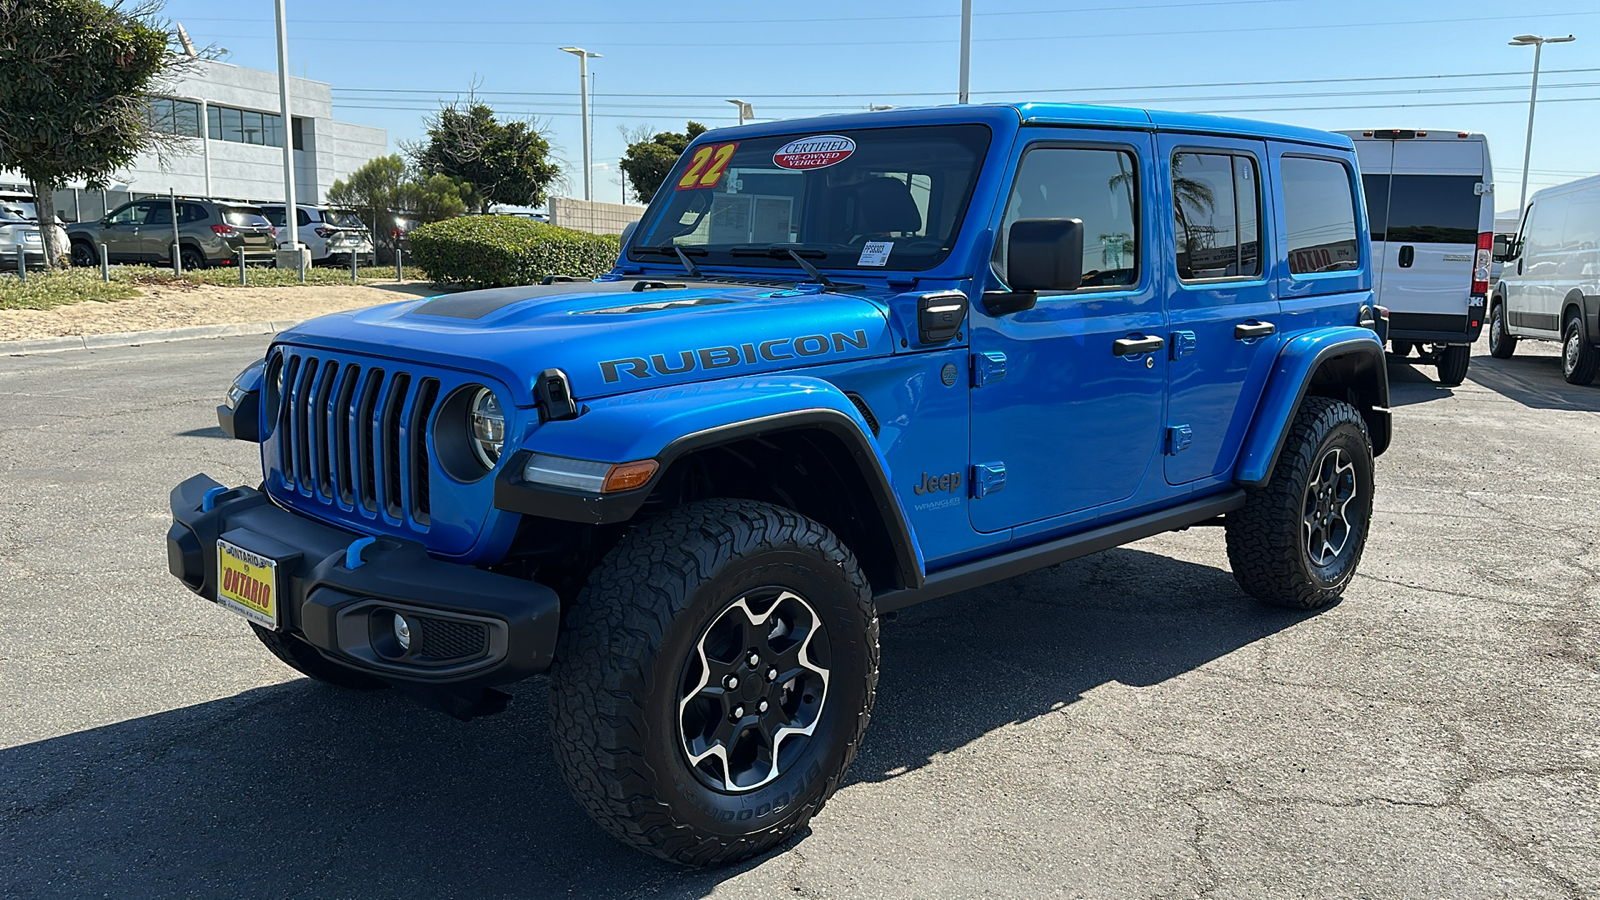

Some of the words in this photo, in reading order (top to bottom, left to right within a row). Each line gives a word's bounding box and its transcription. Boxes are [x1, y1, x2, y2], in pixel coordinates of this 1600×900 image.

[782, 152, 840, 161] PRE-OWNED
[784, 140, 849, 154] CERTIFIED
[679, 143, 735, 188] 22
[788, 158, 829, 167] VEHICLE
[598, 329, 870, 385] RUBICON
[913, 472, 961, 495] Jeep
[914, 497, 960, 511] WRANGLER
[231, 546, 259, 567] ONTARIO
[223, 567, 271, 608] ONTARIO
